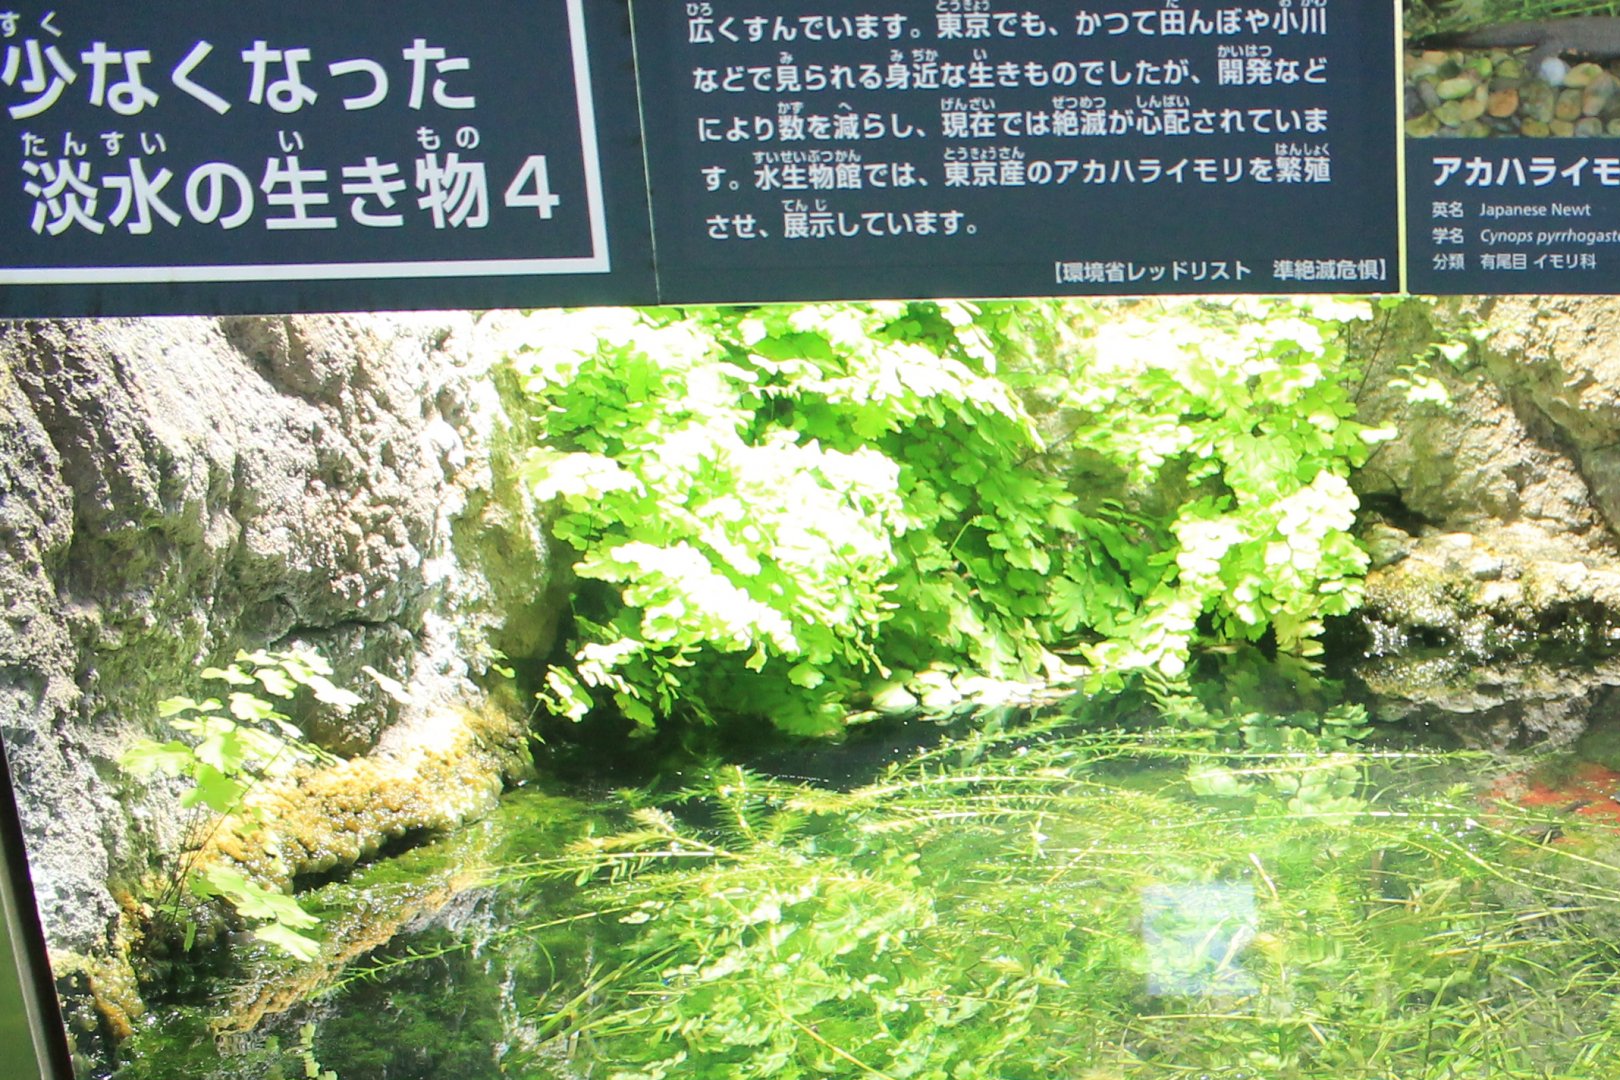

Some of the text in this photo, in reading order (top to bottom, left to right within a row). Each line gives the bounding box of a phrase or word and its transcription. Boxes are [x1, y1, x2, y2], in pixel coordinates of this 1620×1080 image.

[0, 37, 477, 120] 少なくなった
[279, 129, 304, 153] い
[1432, 201, 1592, 220] 英名 Japanese Newt
[1432, 227, 1465, 245] 学名
[1480, 228, 1534, 245] Cynops
[1432, 253, 1597, 271] 分類 有尾目 イモリ科
